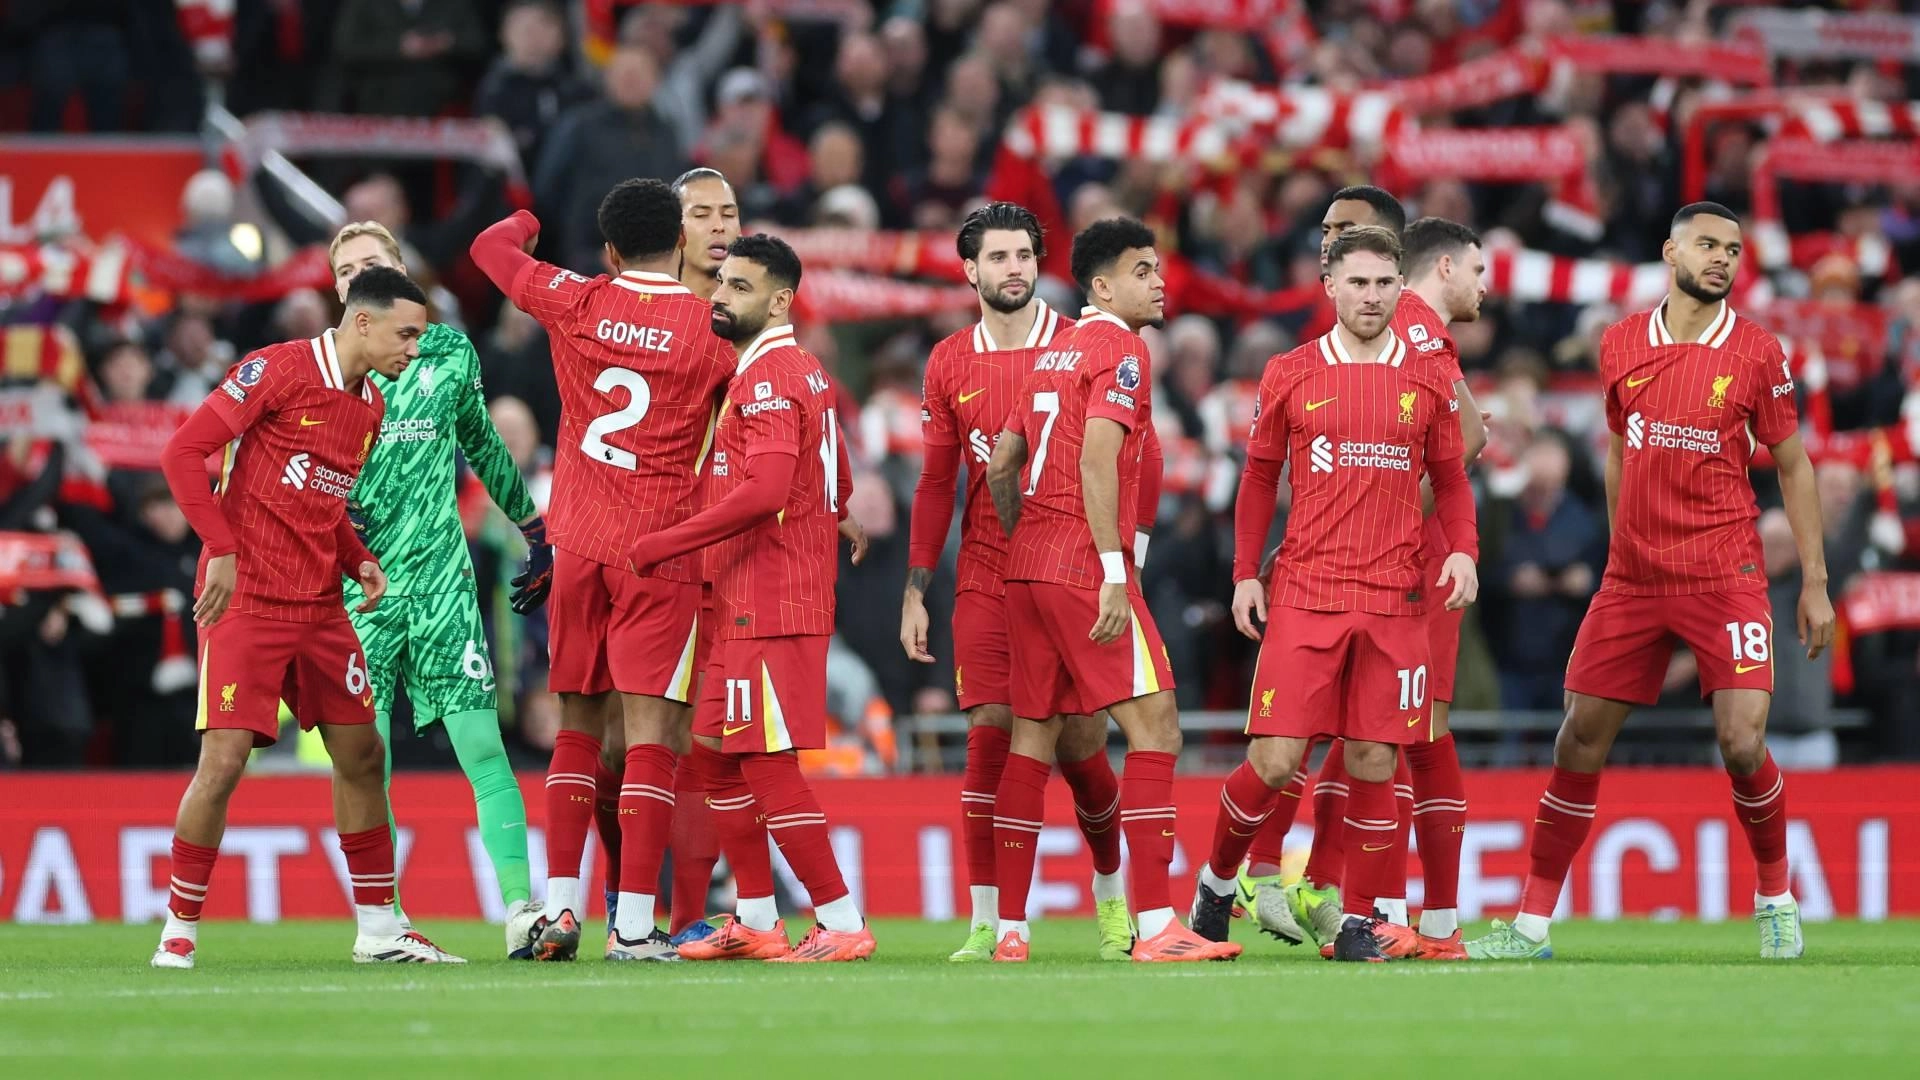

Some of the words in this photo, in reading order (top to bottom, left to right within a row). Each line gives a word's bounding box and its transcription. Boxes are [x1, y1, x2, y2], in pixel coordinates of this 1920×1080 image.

[597, 318, 673, 352] GOMEZ
[740, 397, 791, 417] Expedia
[580, 367, 651, 470] 2
[1398, 412, 1414, 425] LFC
[1649, 421, 1718, 441] standard
[1024, 391, 1060, 496] 7
[1339, 440, 1410, 458] standard
[1648, 433, 1721, 454] chartered
[1339, 452, 1410, 471] chartered
[315, 465, 357, 489] standa
[310, 477, 350, 499] charter
[1726, 621, 1768, 662] 18
[1397, 664, 1427, 711] 10
[219, 704, 235, 712] LFC
[726, 678, 752, 722] 11
[1259, 710, 1273, 718] LFC
[570, 795, 591, 804] LFC
[1004, 841, 1024, 849] LFC
[0, 825, 416, 924] ARTY
